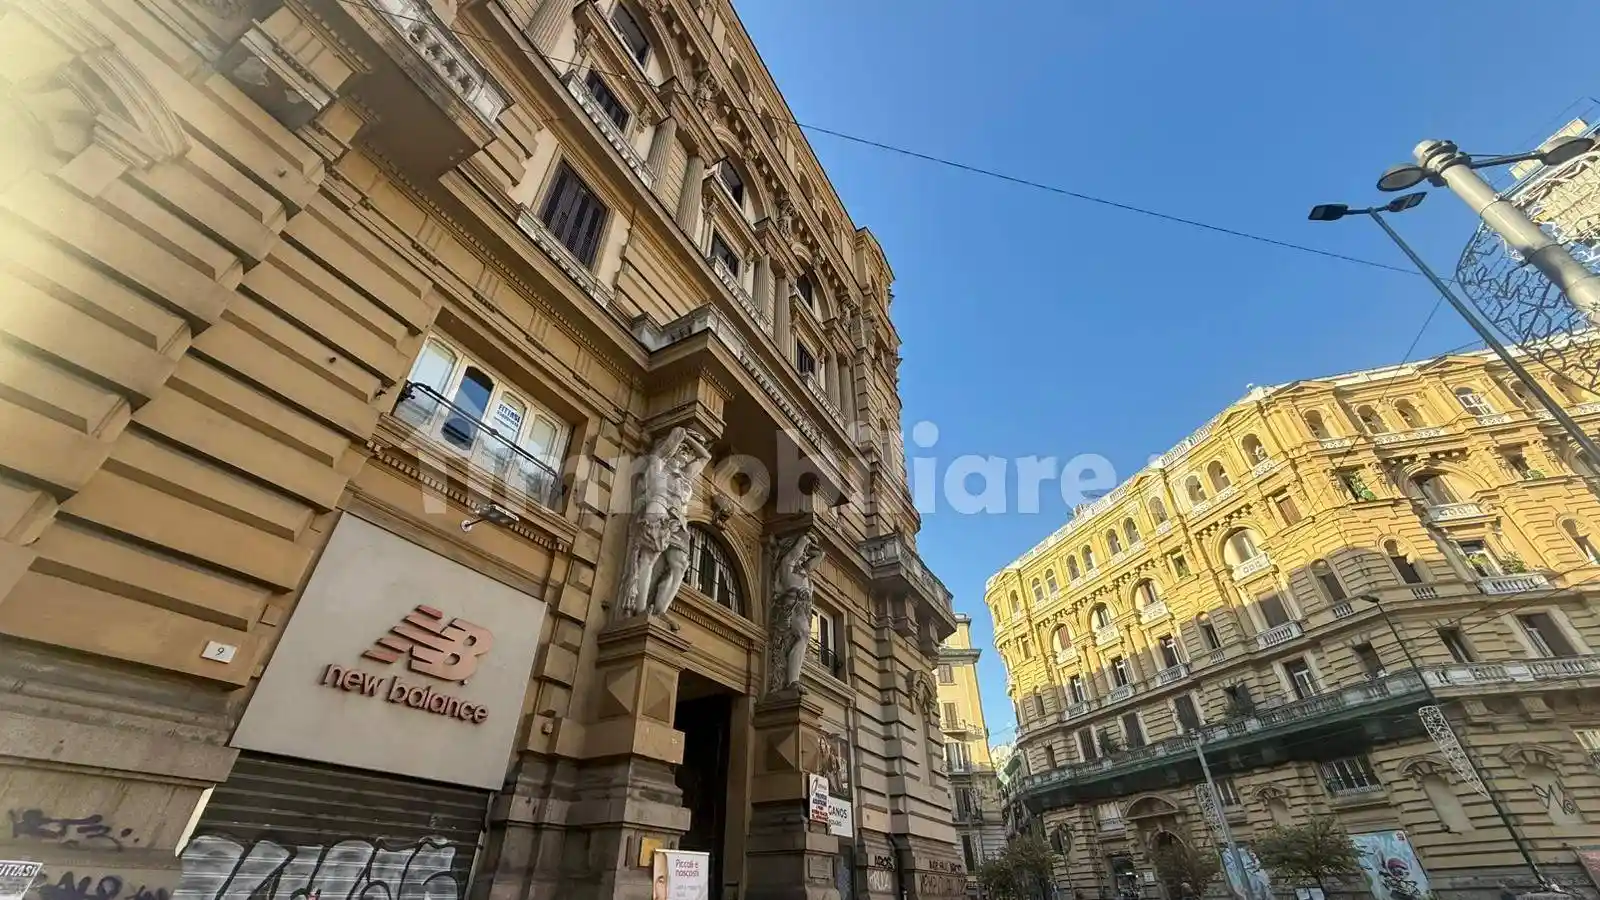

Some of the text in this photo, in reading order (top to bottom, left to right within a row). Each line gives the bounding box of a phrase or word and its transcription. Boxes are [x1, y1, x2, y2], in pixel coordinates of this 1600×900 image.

[215, 647, 225, 656] 9
[319, 663, 489, 724] new balance
